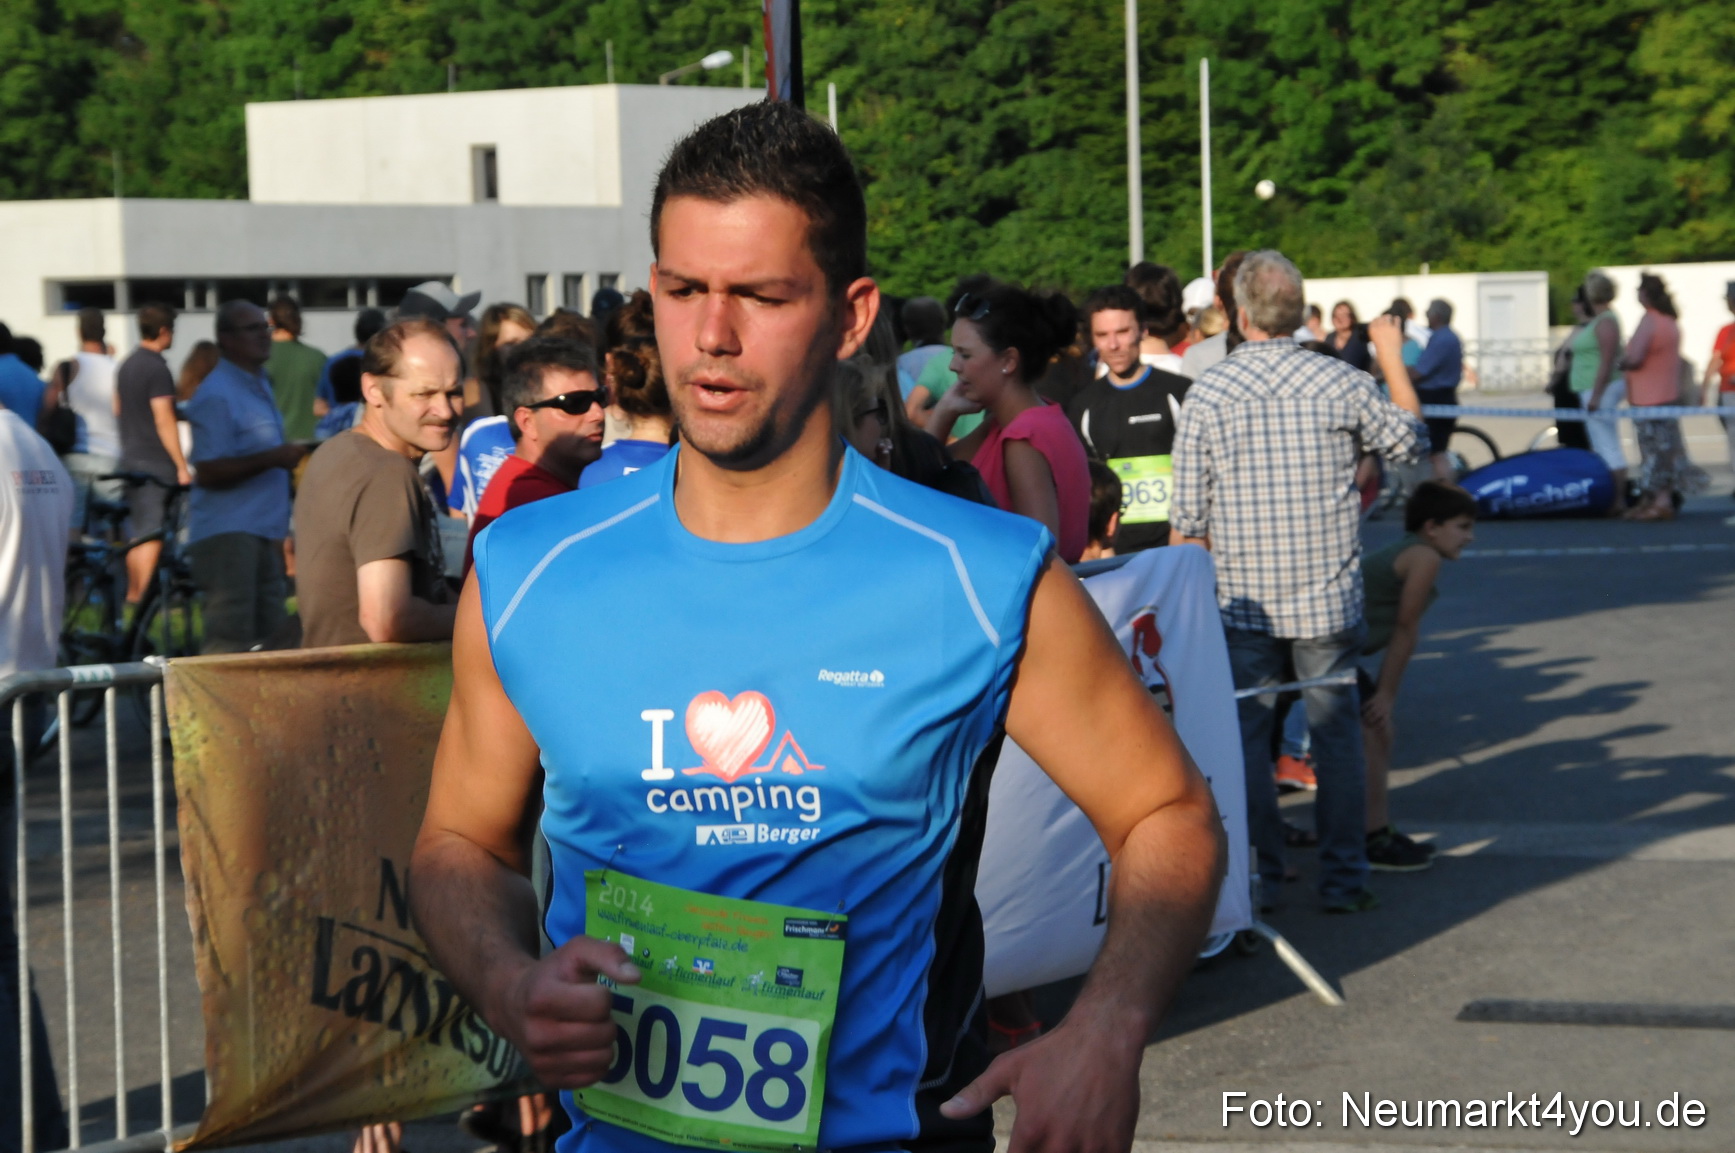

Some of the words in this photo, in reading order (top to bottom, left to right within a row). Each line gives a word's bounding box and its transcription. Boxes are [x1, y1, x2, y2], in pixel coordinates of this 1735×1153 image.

[818, 669, 869, 685] Regatta
[641, 709, 674, 781] I
[647, 777, 821, 822] camping
[757, 824, 820, 844] Berger
[599, 883, 653, 917] 2014
